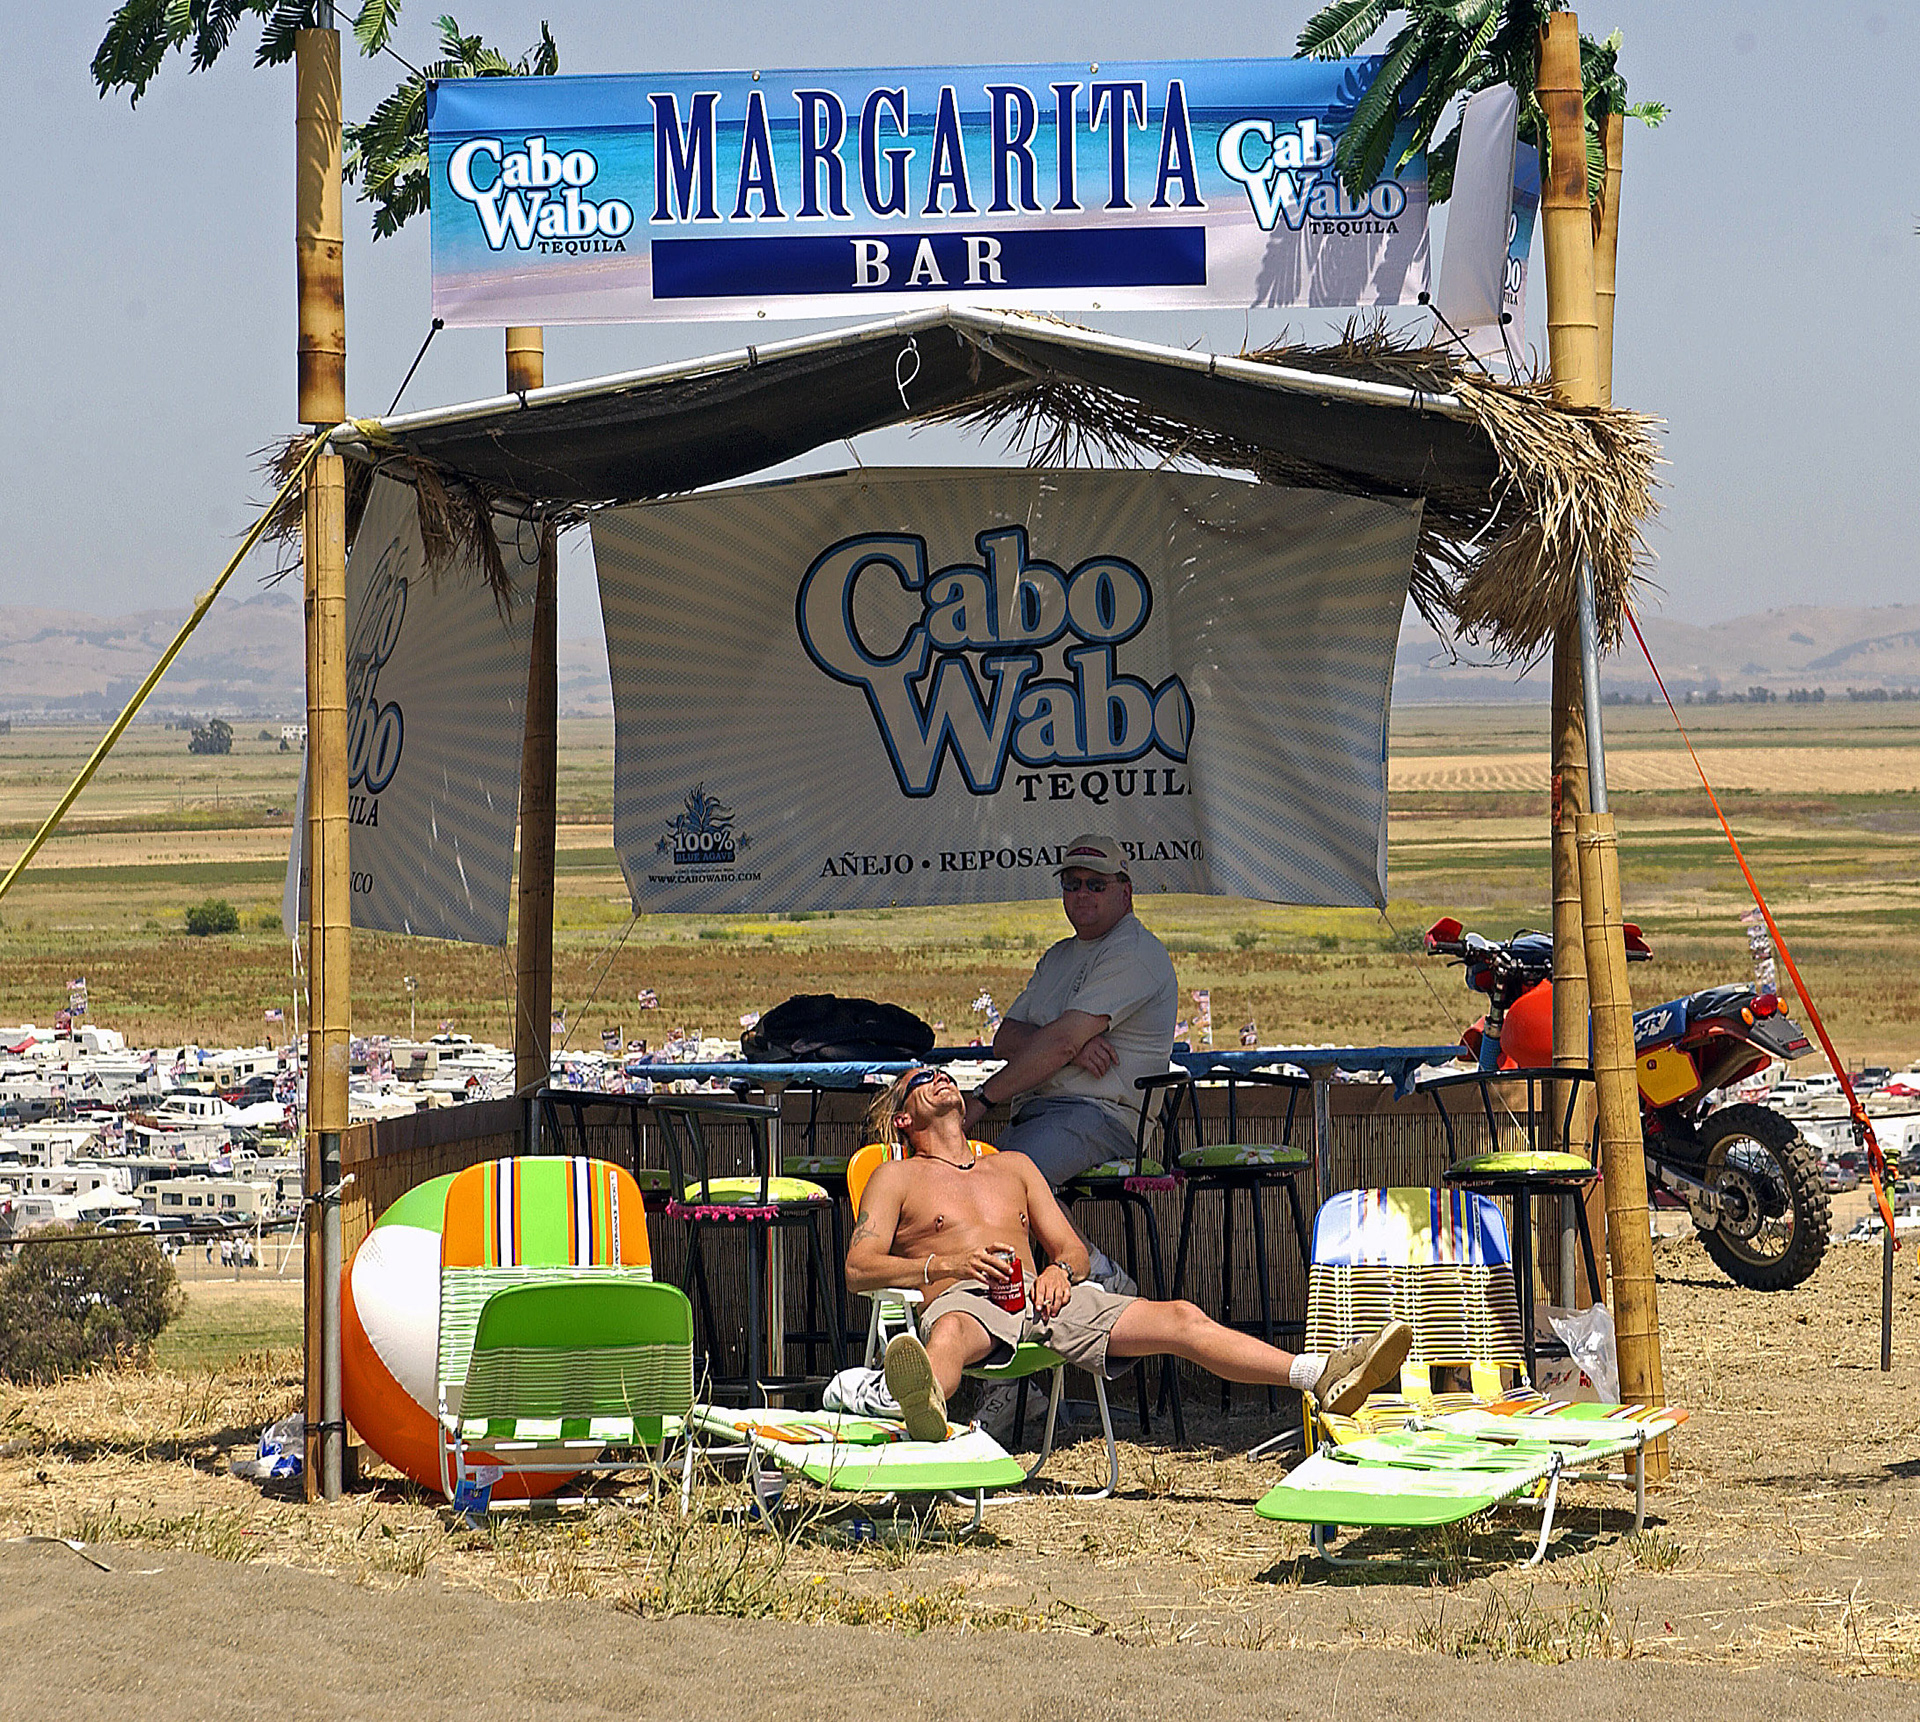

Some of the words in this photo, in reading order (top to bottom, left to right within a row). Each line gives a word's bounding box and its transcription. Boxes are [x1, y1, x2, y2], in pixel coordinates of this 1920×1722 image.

[447, 134, 599, 203] Cabo
[648, 78, 1209, 222] MARGARITA
[1216, 116, 1345, 183] Cab
[473, 186, 634, 250] Wabo
[1309, 220, 1399, 237] TEQUILA
[538, 239, 627, 256] TEQUILA
[849, 235, 1008, 288] BAR
[795, 524, 1154, 688] Cabo
[1015, 767, 1192, 805] TEQUIL
[675, 831, 735, 853] 100%
[675, 853, 700, 863] BLUE
[702, 851, 735, 862] AGAVE
[819, 851, 914, 878] AÑEJO
